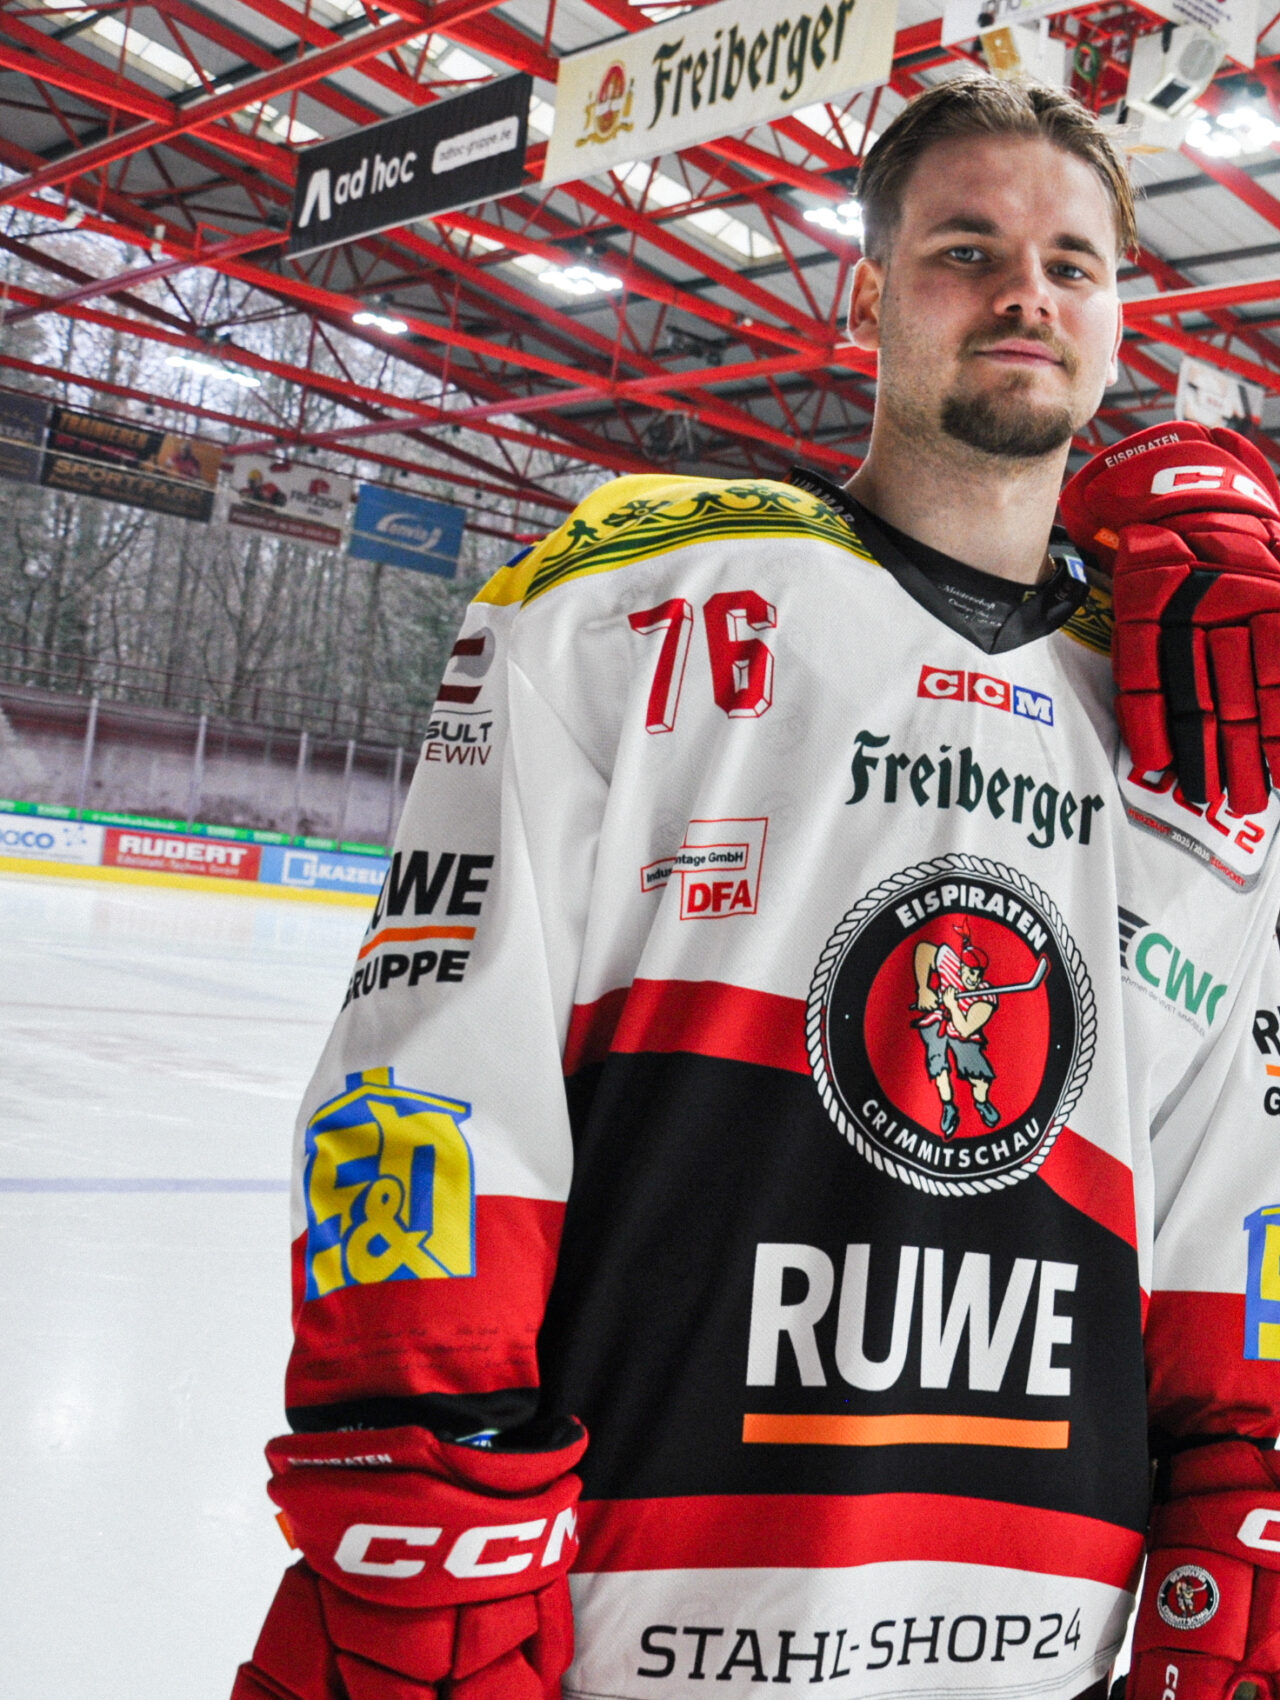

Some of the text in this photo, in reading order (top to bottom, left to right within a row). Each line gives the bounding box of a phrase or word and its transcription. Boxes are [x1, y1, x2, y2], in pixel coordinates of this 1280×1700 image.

[648, 0, 857, 129] Freiberger
[369, 149, 417, 194] hoc
[1104, 432, 1180, 468] EISPIRATEN
[627, 590, 778, 735] 76
[922, 673, 1052, 725] CCM
[425, 721, 493, 743] SULT
[845, 730, 1105, 849] Freiberger
[118, 834, 248, 866] RUDERT
[707, 851, 745, 863] GmbH
[687, 879, 753, 913] DFA
[894, 884, 1047, 951] EISPIRATEN
[343, 949, 470, 1008] RUPPE
[861, 1099, 1041, 1168] CRIMMITSCHAU
[745, 1242, 1079, 1397] RUWE
[637, 1608, 1081, 1684] STAHL-SHOP24
